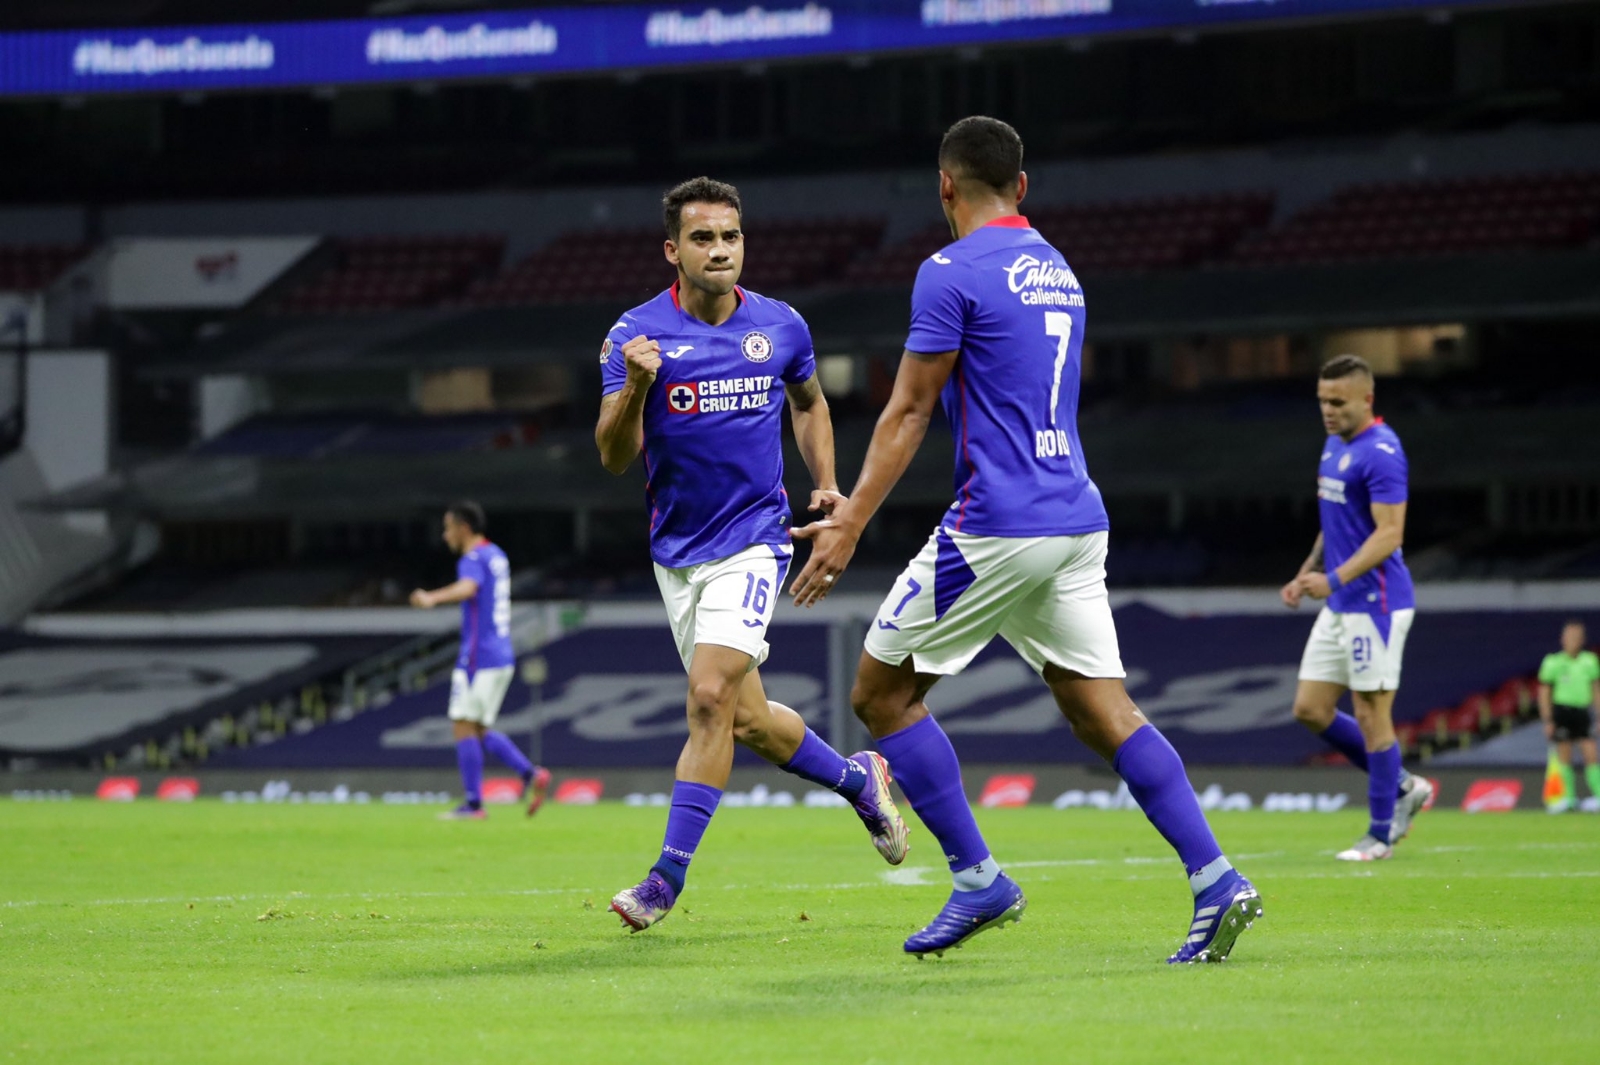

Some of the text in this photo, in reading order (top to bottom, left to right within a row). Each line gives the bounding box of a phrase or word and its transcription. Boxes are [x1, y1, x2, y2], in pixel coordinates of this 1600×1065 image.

[1045, 311, 1072, 424] 7
[698, 376, 771, 396] CEMENTO
[699, 391, 769, 413] CRUZ AZUL
[741, 571, 770, 615] 16
[893, 577, 922, 617] 7
[1353, 636, 1371, 661] 21
